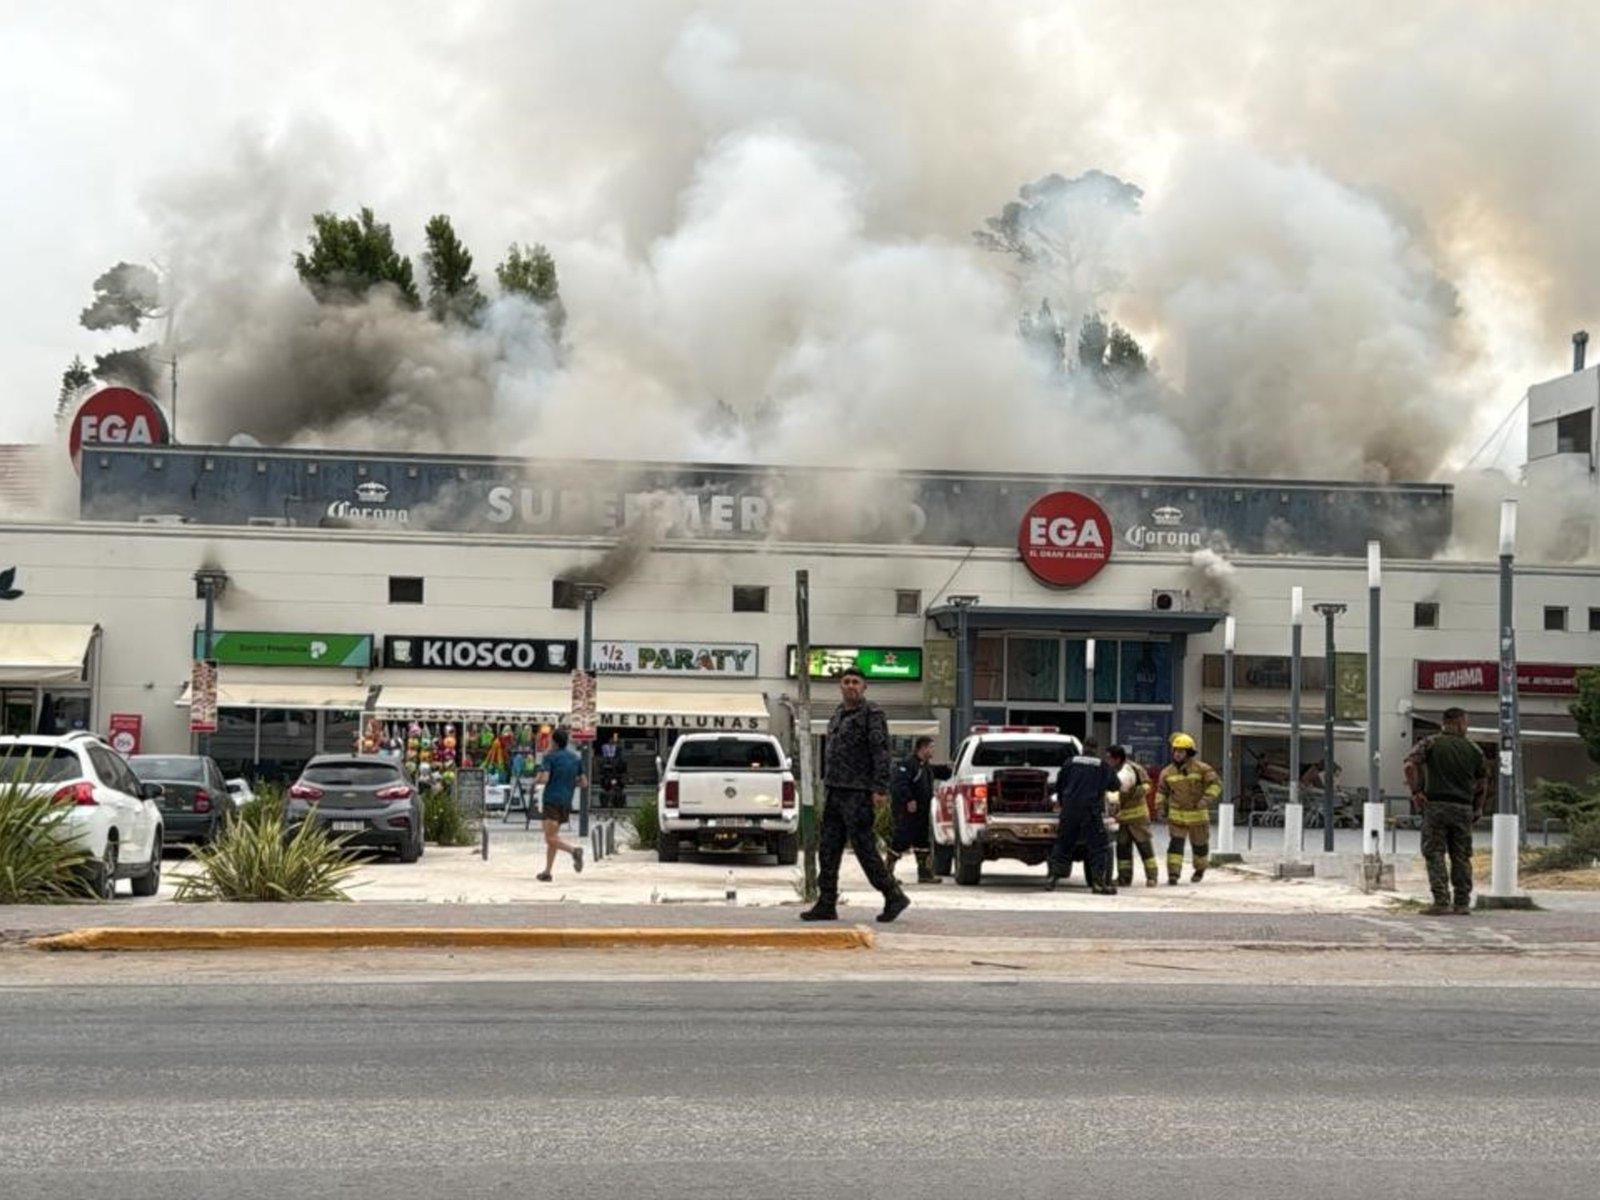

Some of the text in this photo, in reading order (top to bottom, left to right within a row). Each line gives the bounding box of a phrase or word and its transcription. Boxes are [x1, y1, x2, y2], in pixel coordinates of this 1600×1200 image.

[81, 414, 152, 443] EGA
[327, 500, 409, 523] Corona
[1029, 517, 1104, 547] EGA
[1125, 525, 1200, 549] Corona
[422, 640, 535, 667] KIOSCO
[637, 647, 752, 671] PARATY
[592, 661, 632, 672] LUNAS
[1433, 667, 1483, 689] BRAHMA
[600, 713, 758, 729] MEDIALUNAS
